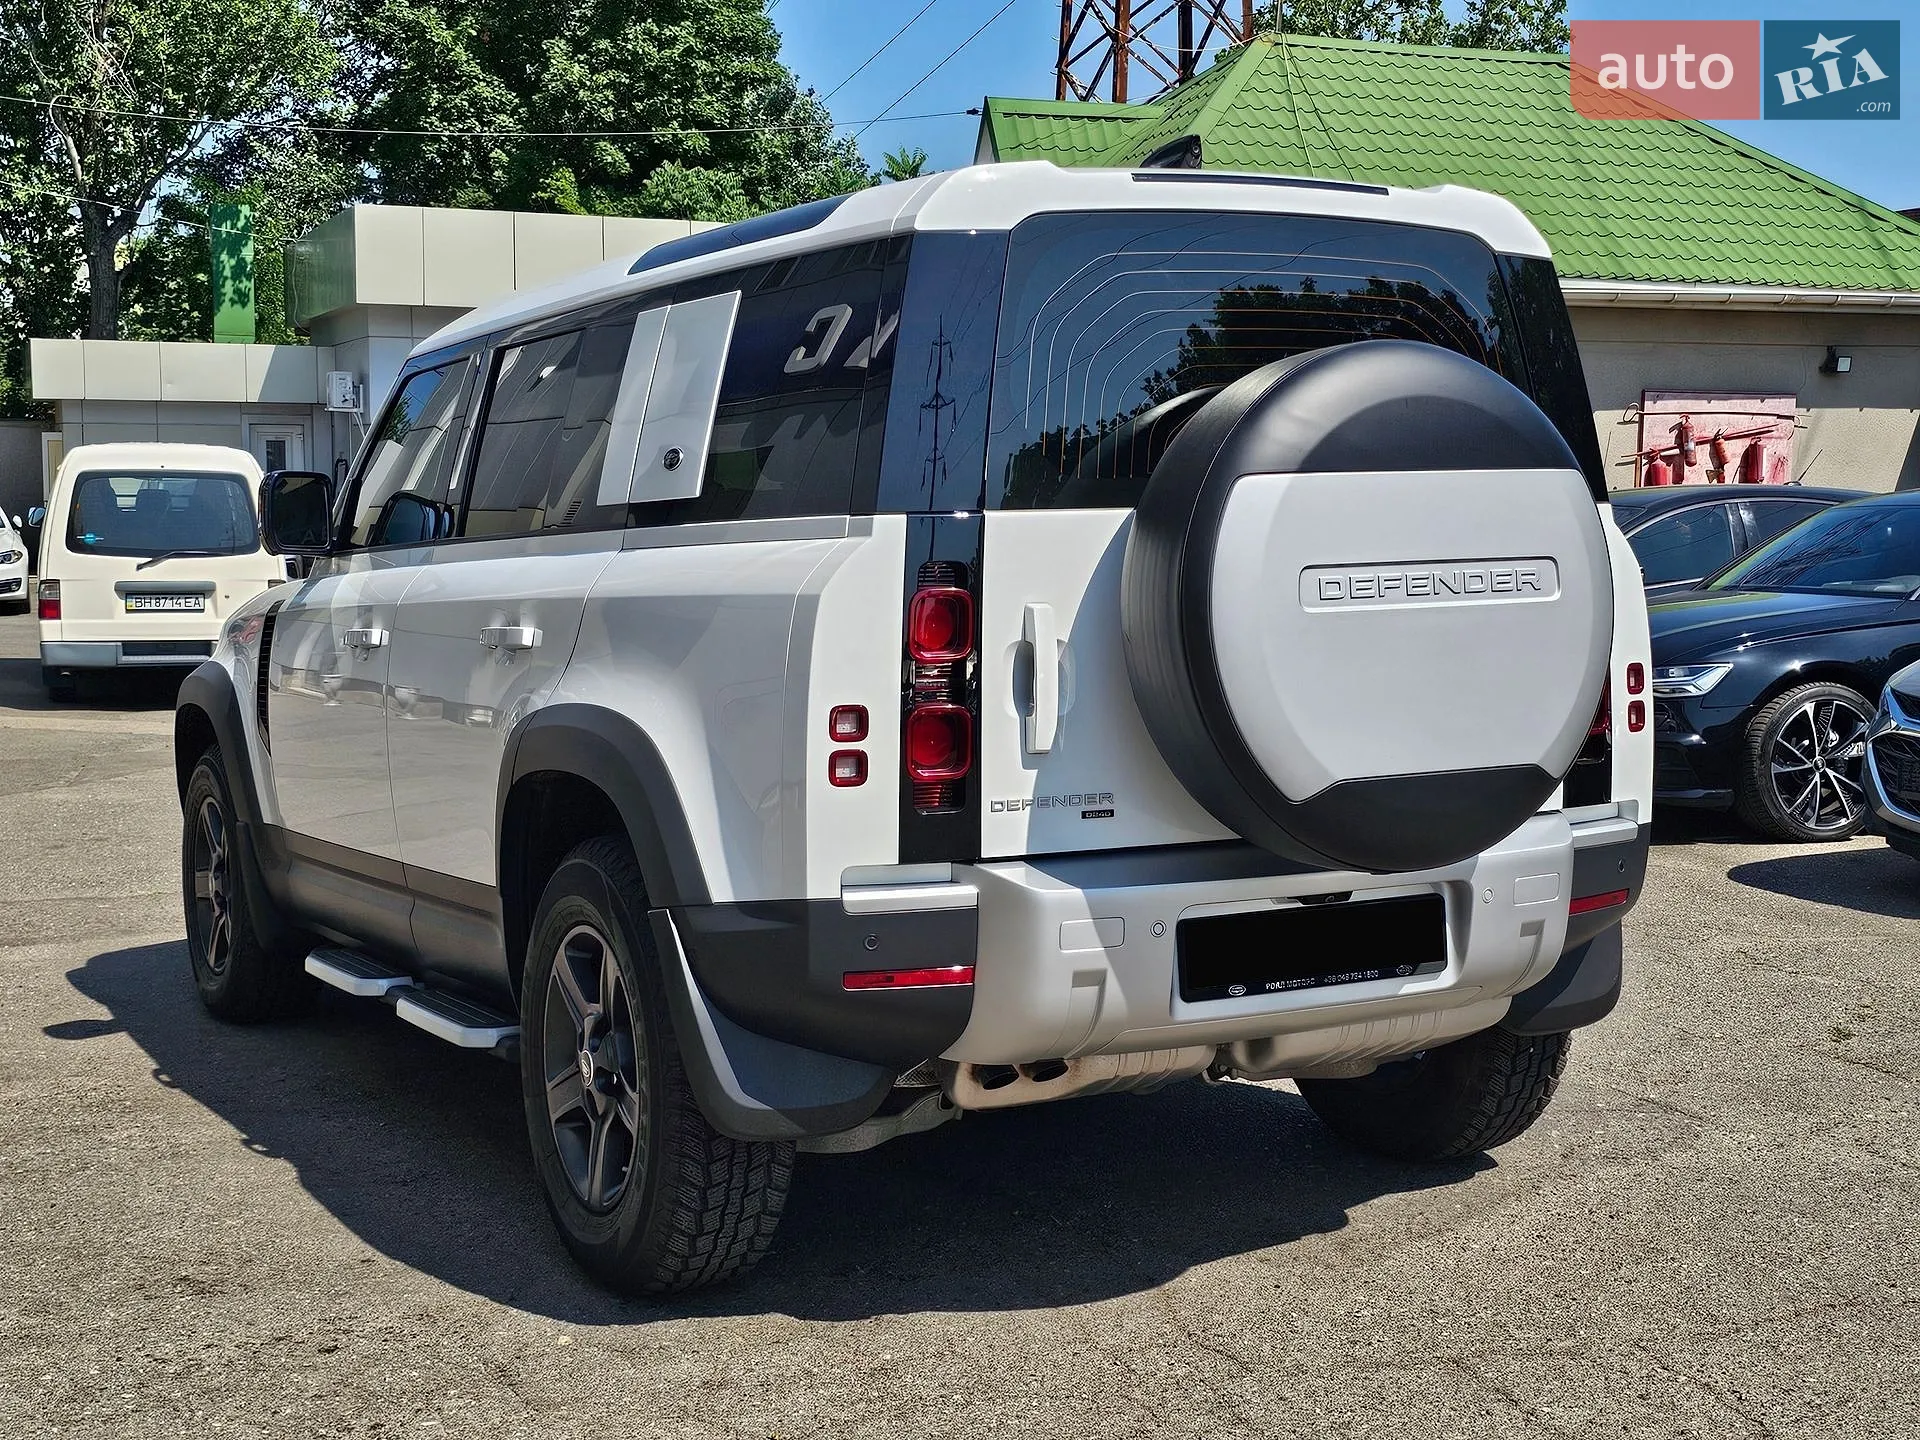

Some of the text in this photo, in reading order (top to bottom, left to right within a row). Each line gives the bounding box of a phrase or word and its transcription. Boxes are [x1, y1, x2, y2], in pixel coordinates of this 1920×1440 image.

[1318, 567, 1542, 601] DEFENDER
[134, 597, 201, 608] BH 8714 EA
[990, 792, 1115, 813] DEFENDER
